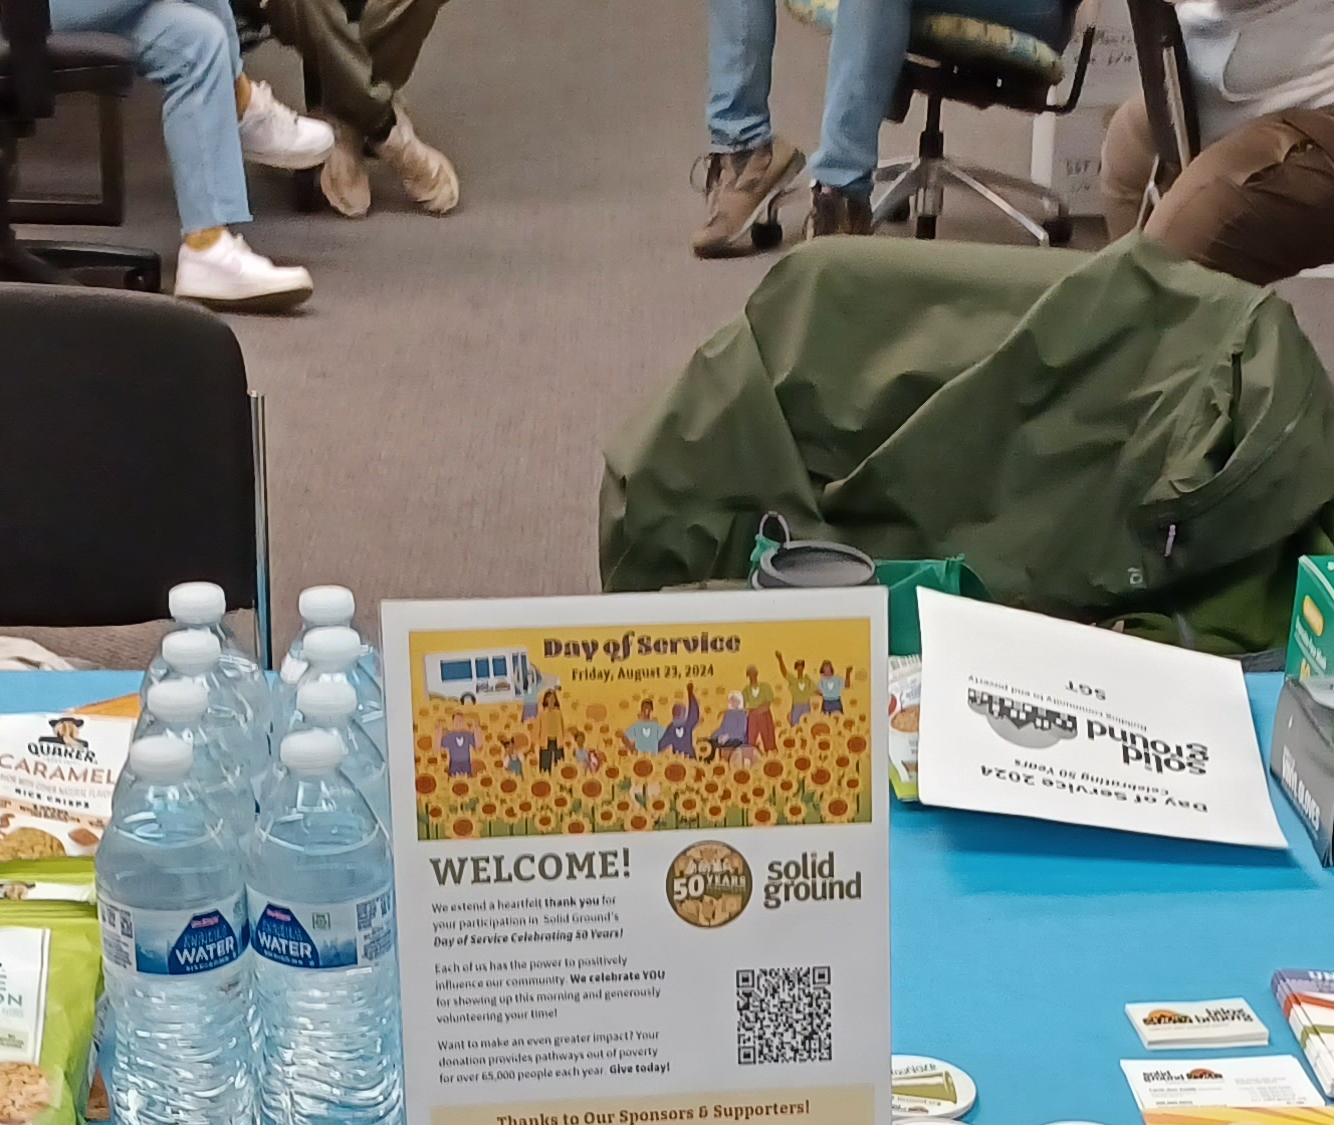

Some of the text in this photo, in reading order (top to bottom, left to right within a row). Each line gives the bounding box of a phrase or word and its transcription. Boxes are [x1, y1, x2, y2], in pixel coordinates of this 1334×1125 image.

[543, 631, 741, 663] Day of Service
[571, 666, 614, 683] Friday,
[618, 664, 661, 681] August
[685, 664, 714, 678] 2024
[1066, 680, 1106, 700] SGT
[1087, 719, 1209, 762] ground
[28, 743, 96, 764] QUAKER
[1122, 743, 1207, 775] solid
[981, 765, 1035, 785] 2024
[429, 847, 631, 886] WELCOME!
[768, 851, 834, 880] solid
[673, 875, 704, 900] 50
[764, 871, 861, 909] ground
[431, 903, 448, 914] We
[451, 901, 486, 912] extend
[498, 899, 542, 911] heartfelt
[544, 896, 576, 908] thank
[579, 897, 599, 909] you
[602, 895, 616, 905] for
[433, 920, 456, 933] your
[459, 916, 526, 931] participation
[528, 915, 538, 925] in
[544, 913, 569, 924] Solid
[258, 931, 312, 959] WATER
[434, 935, 454, 949] Day
[457, 934, 468, 946] of
[470, 932, 508, 945] Service
[511, 930, 572, 943] Celebrating
[590, 928, 623, 939] Years!
[176, 936, 236, 966] WATER
[435, 962, 460, 975] Each
[510, 958, 527, 970] the
[529, 958, 562, 972] power
[578, 955, 628, 969] positively
[435, 977, 484, 991] influence
[486, 977, 502, 988] our
[570, 973, 587, 984] We
[589, 971, 640, 983] celebrate
[643, 970, 665, 981] YOU
[453, 995, 496, 1007] showing
[515, 992, 534, 1003] this
[537, 991, 580, 1002] morning
[583, 989, 602, 1000] and
[604, 986, 661, 1000] generously
[436, 1010, 503, 1024] volunteering
[505, 1009, 528, 1022] your
[437, 1040, 465, 1051] Want
[481, 1036, 509, 1048] make
[511, 1037, 524, 1047] an
[527, 1035, 552, 1046] even
[554, 1033, 590, 1047] greater
[593, 1030, 633, 1044] impact?
[636, 1030, 659, 1041] Your
[439, 1055, 486, 1067] donation
[488, 1052, 533, 1066] provides
[535, 1050, 584, 1064] pathways
[587, 1049, 604, 1059] out
[619, 1047, 658, 1062] poverty
[457, 1072, 478, 1083] over
[517, 1067, 553, 1081] people
[555, 1065, 580, 1077] each
[609, 1063, 632, 1075] Give
[635, 1061, 670, 1075] today!
[584, 1111, 616, 1125] Our
[619, 1106, 695, 1125] Sponsors
[699, 1105, 709, 1119] &
[713, 1099, 810, 1121] Supporters!
